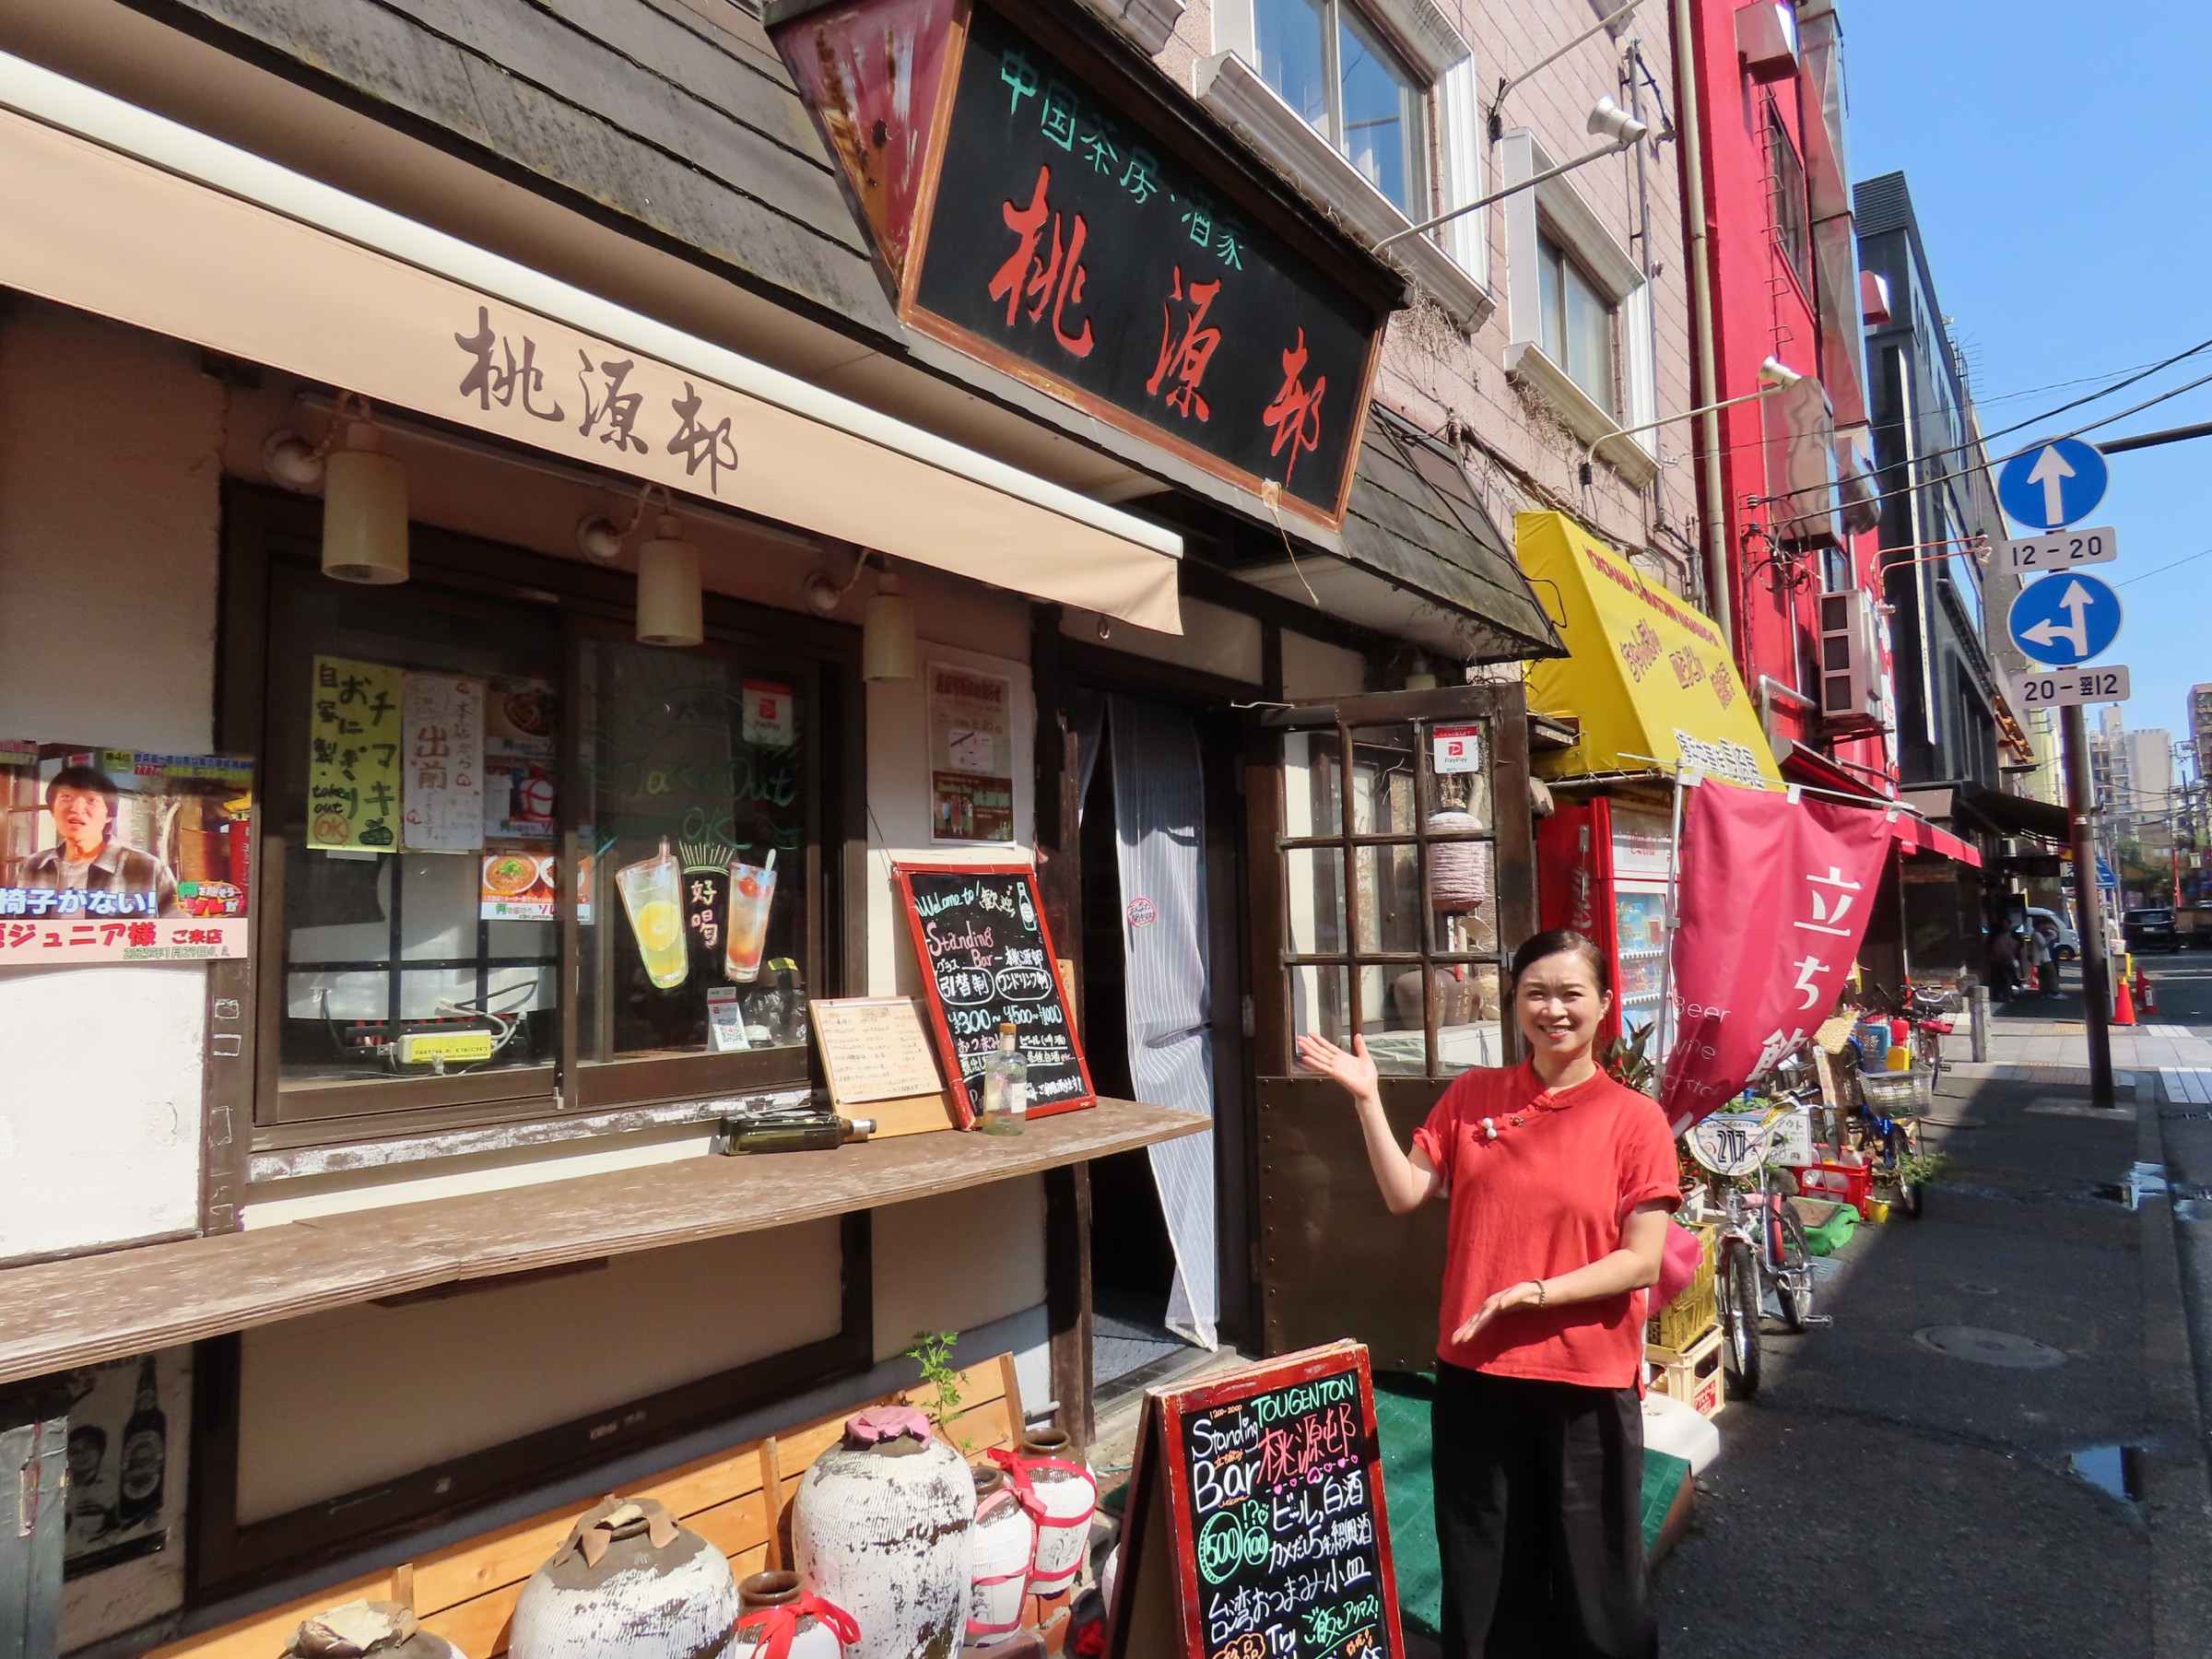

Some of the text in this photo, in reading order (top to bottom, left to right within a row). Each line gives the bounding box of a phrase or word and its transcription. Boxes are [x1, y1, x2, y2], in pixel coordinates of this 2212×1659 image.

[988, 165, 1326, 487] 桃源邨
[454, 306, 738, 495] 桃源邨
[755, 720, 781, 731] PayPay
[338, 676, 371, 820] おにぎり
[364, 691, 396, 817] チマキ
[415, 724, 451, 790] 出前
[1444, 756, 1468, 764] PayPay
[312, 784, 345, 801] take
[314, 802, 344, 815] out
[0, 888, 157, 915] 椅子がない!
[691, 879, 720, 949] 好喝
[171, 929, 222, 945] ご来店
[926, 921, 994, 957] Standing
[936, 959, 960, 972] グラス
[971, 948, 993, 968] Bar
[939, 972, 990, 997] 引替制
[1717, 1130, 1746, 1162] 217
[1251, 1374, 1355, 1429] TOUGENTON
[1191, 1411, 1260, 1462] Standing
[1256, 1402, 1356, 1485] 桃源邨
[1193, 1460, 1261, 1514] Bar
[1208, 1556, 1372, 1644] 台湾おつまみ小皿
[1265, 1623, 1296, 1654] Try
